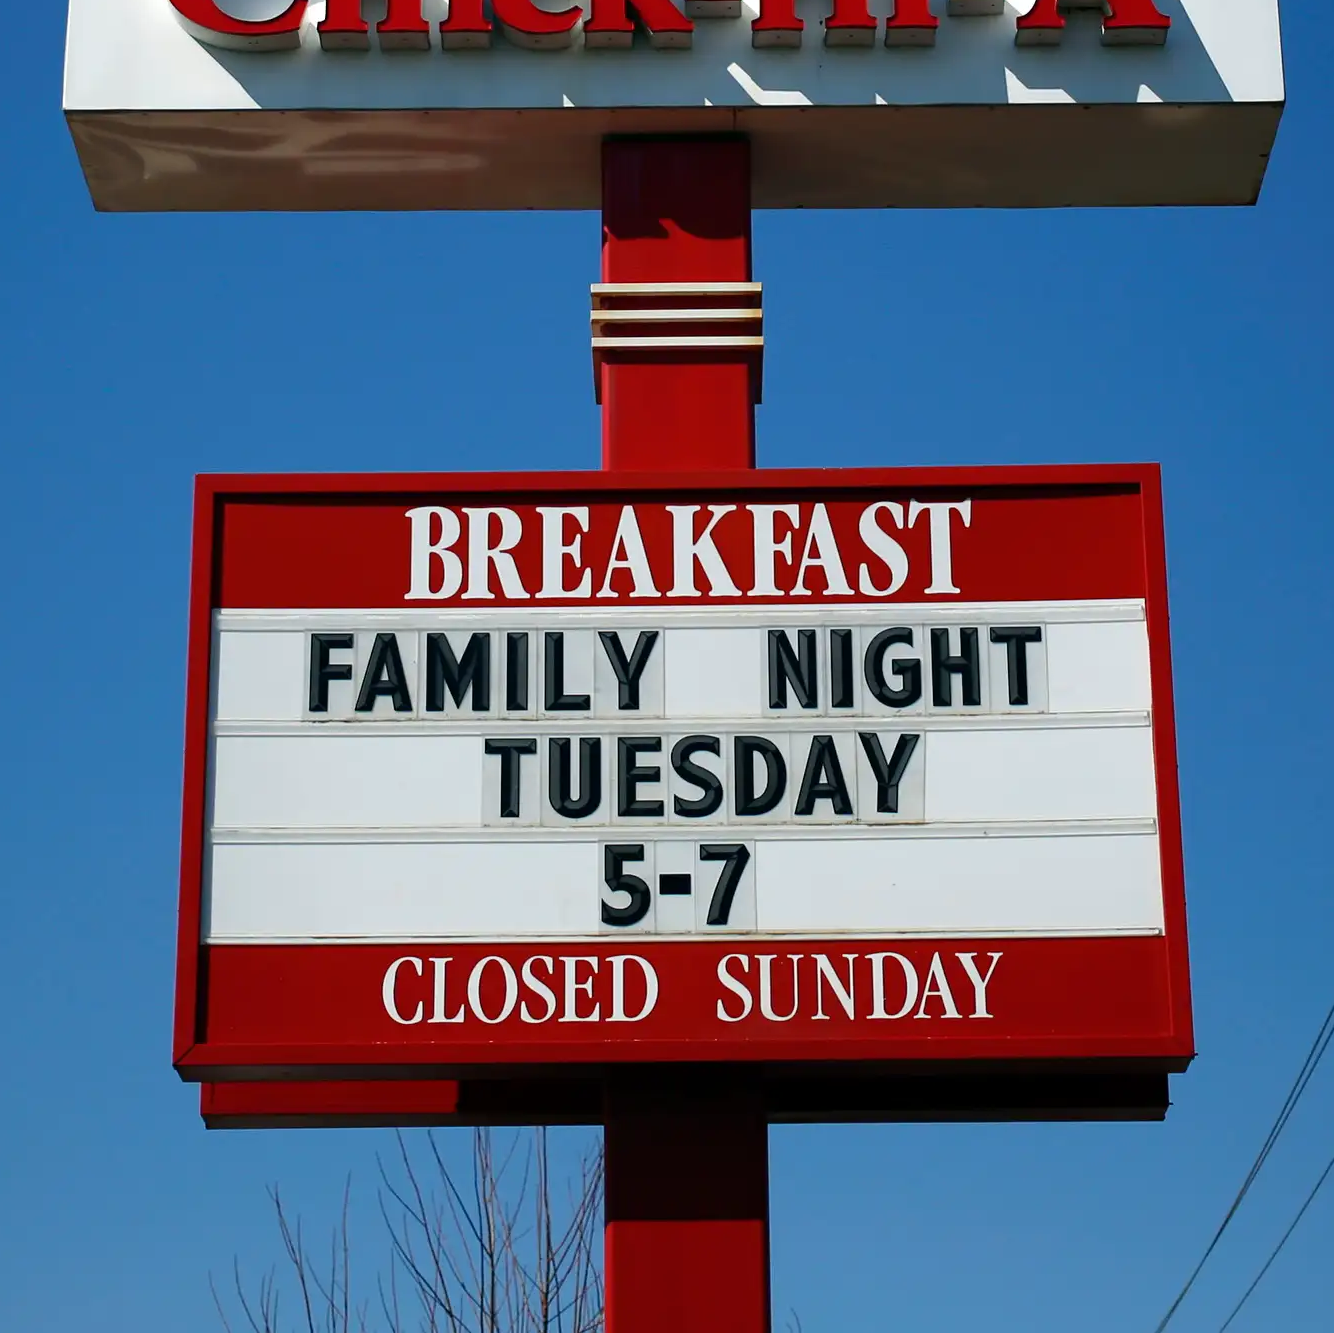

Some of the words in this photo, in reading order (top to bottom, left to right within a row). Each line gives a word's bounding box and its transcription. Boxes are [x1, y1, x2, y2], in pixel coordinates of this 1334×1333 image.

[403, 499, 972, 600] BREAKFAST
[308, 630, 660, 713] FAMILY
[767, 625, 1043, 710] NIGHT
[484, 731, 921, 819] TUESDAY
[601, 843, 751, 927] 5-7
[381, 954, 660, 1025] CLOSED
[716, 951, 1004, 1022] SUNDAY
